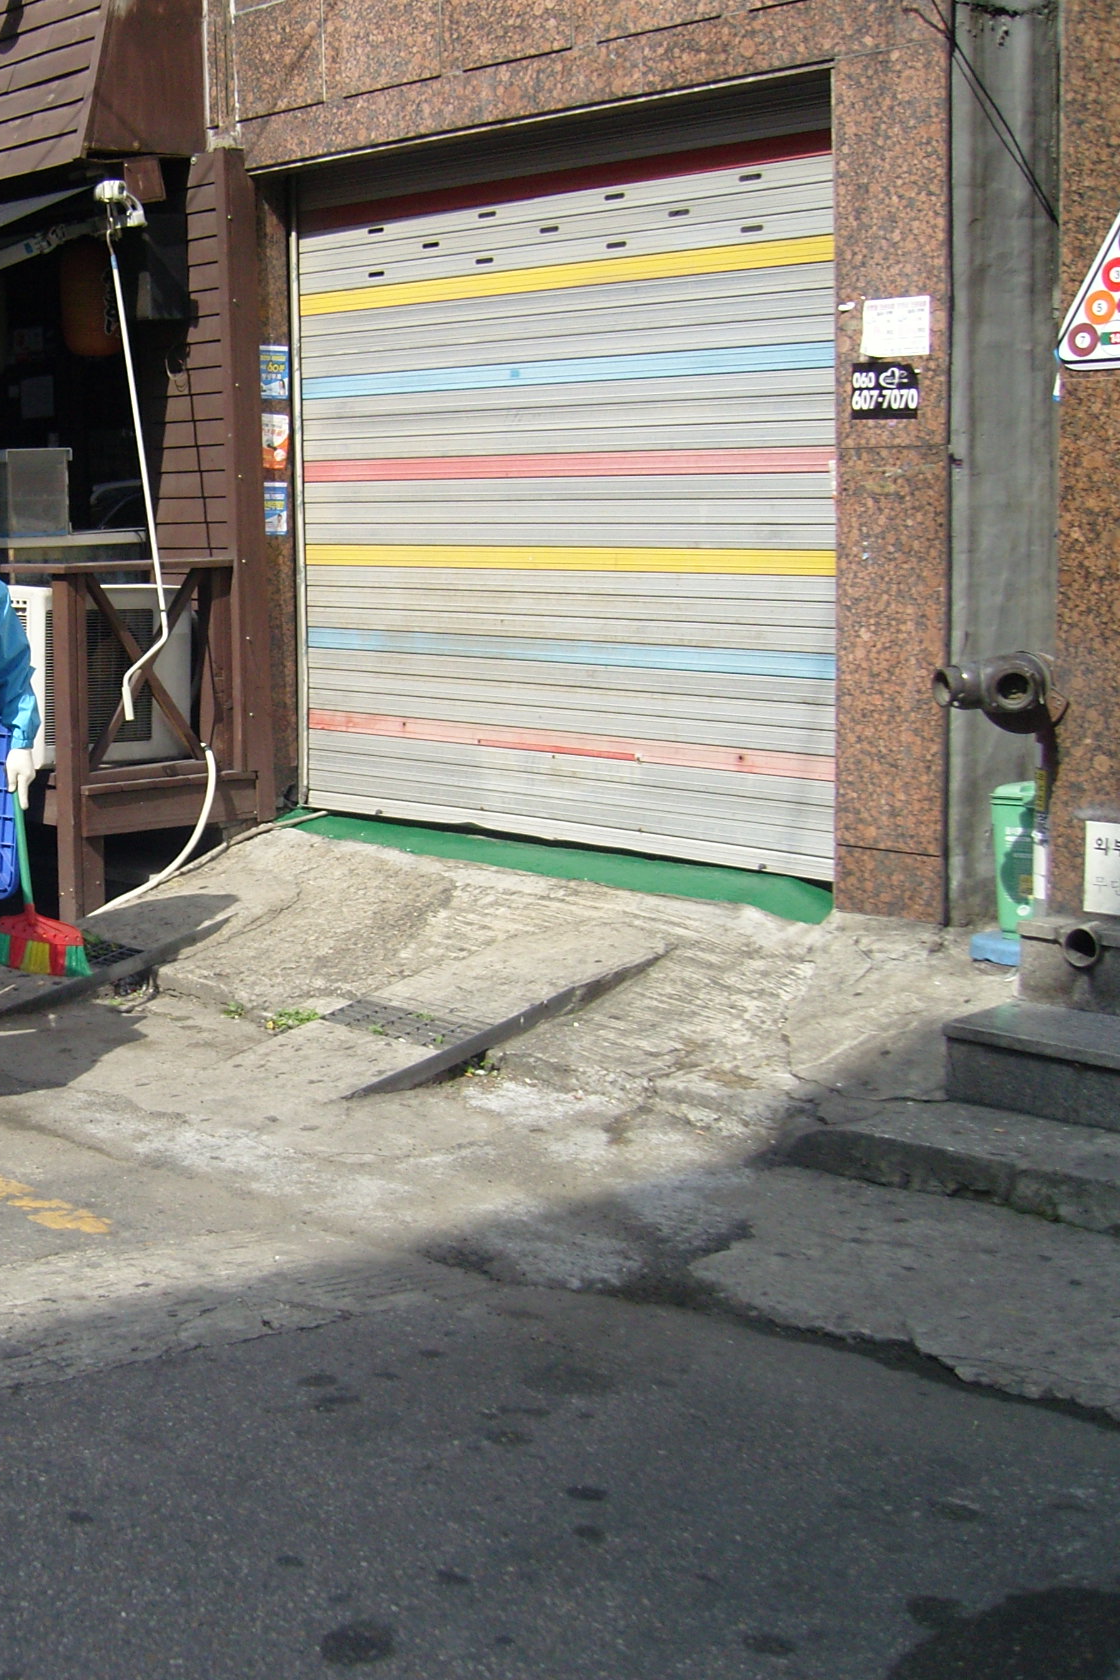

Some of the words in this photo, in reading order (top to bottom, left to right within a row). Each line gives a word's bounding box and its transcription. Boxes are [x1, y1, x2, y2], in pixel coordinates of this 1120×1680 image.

[1096, 302, 1103, 313] 5
[852, 371, 876, 389] 060
[851, 388, 919, 411] 607-7070
